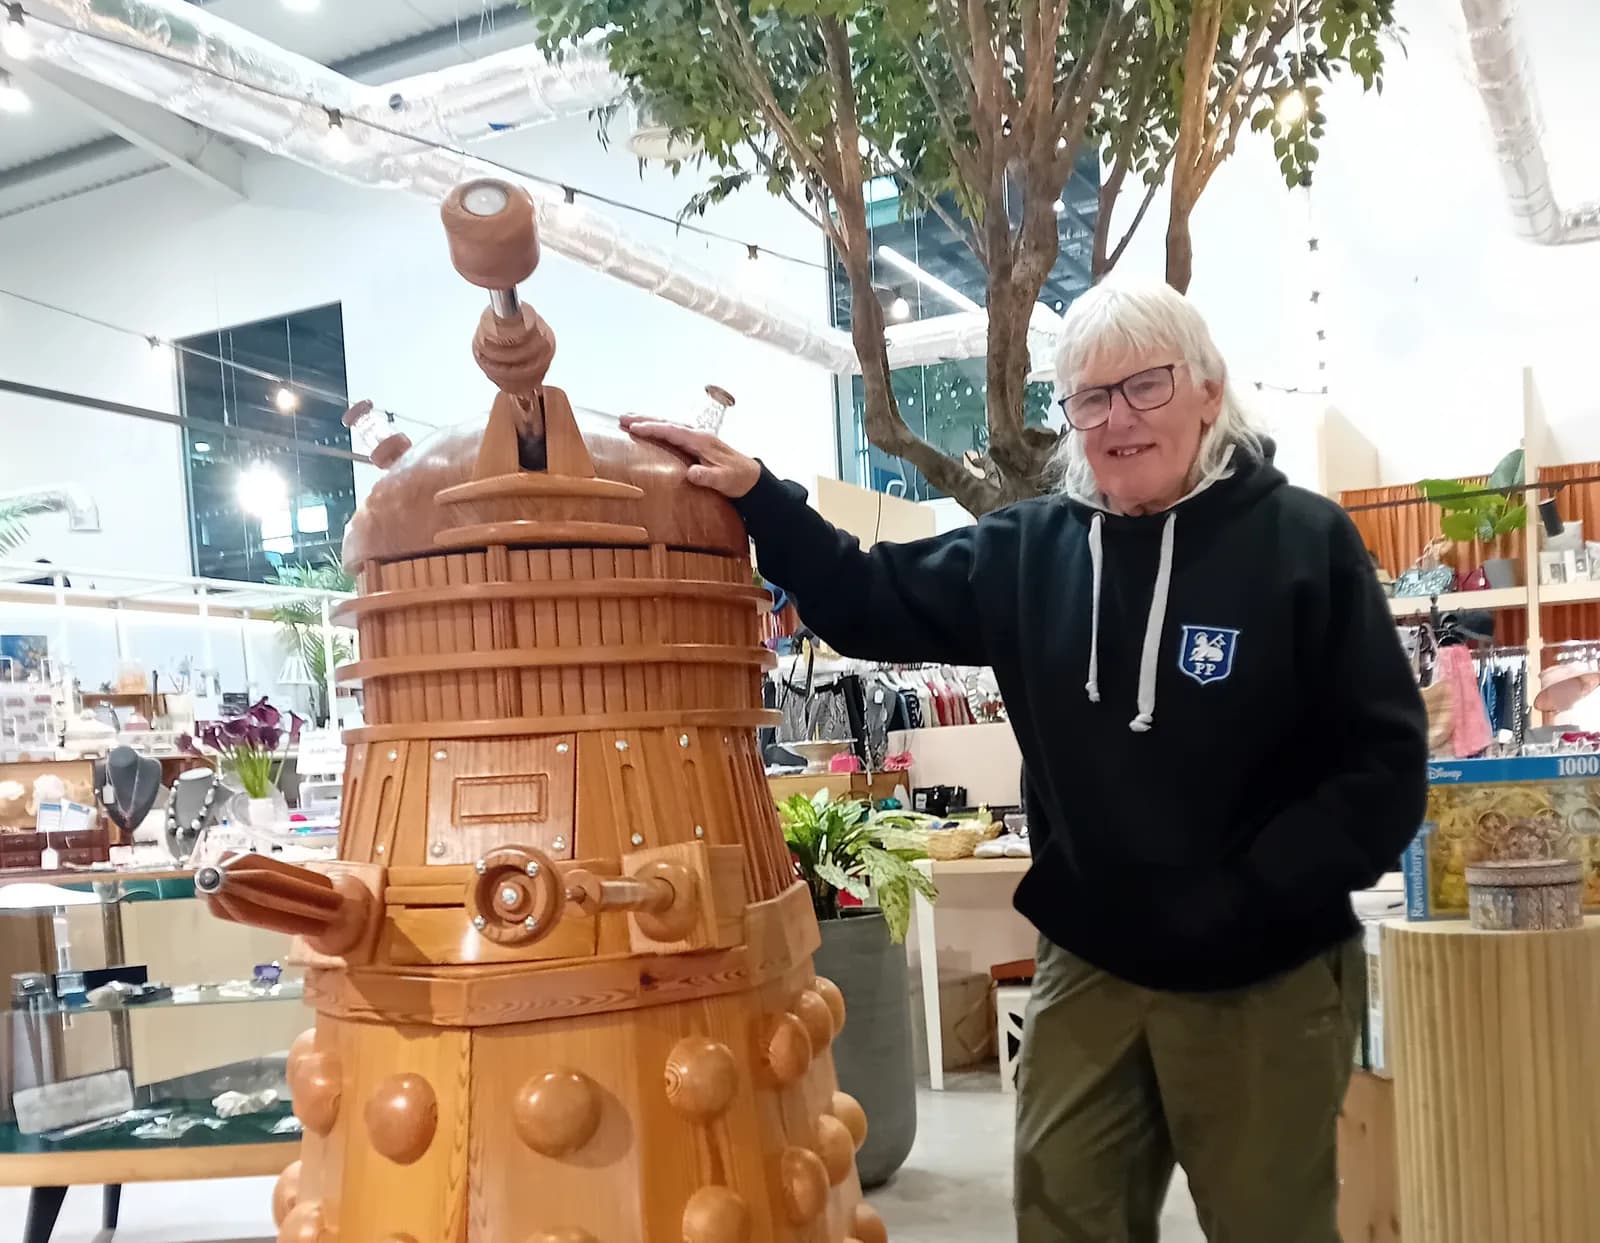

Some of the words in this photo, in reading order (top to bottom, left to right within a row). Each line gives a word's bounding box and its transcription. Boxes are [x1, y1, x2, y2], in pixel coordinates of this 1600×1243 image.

[1194, 663, 1216, 676] PP
[1557, 756, 1599, 776] 1000
[1428, 767, 1463, 781] Disney
